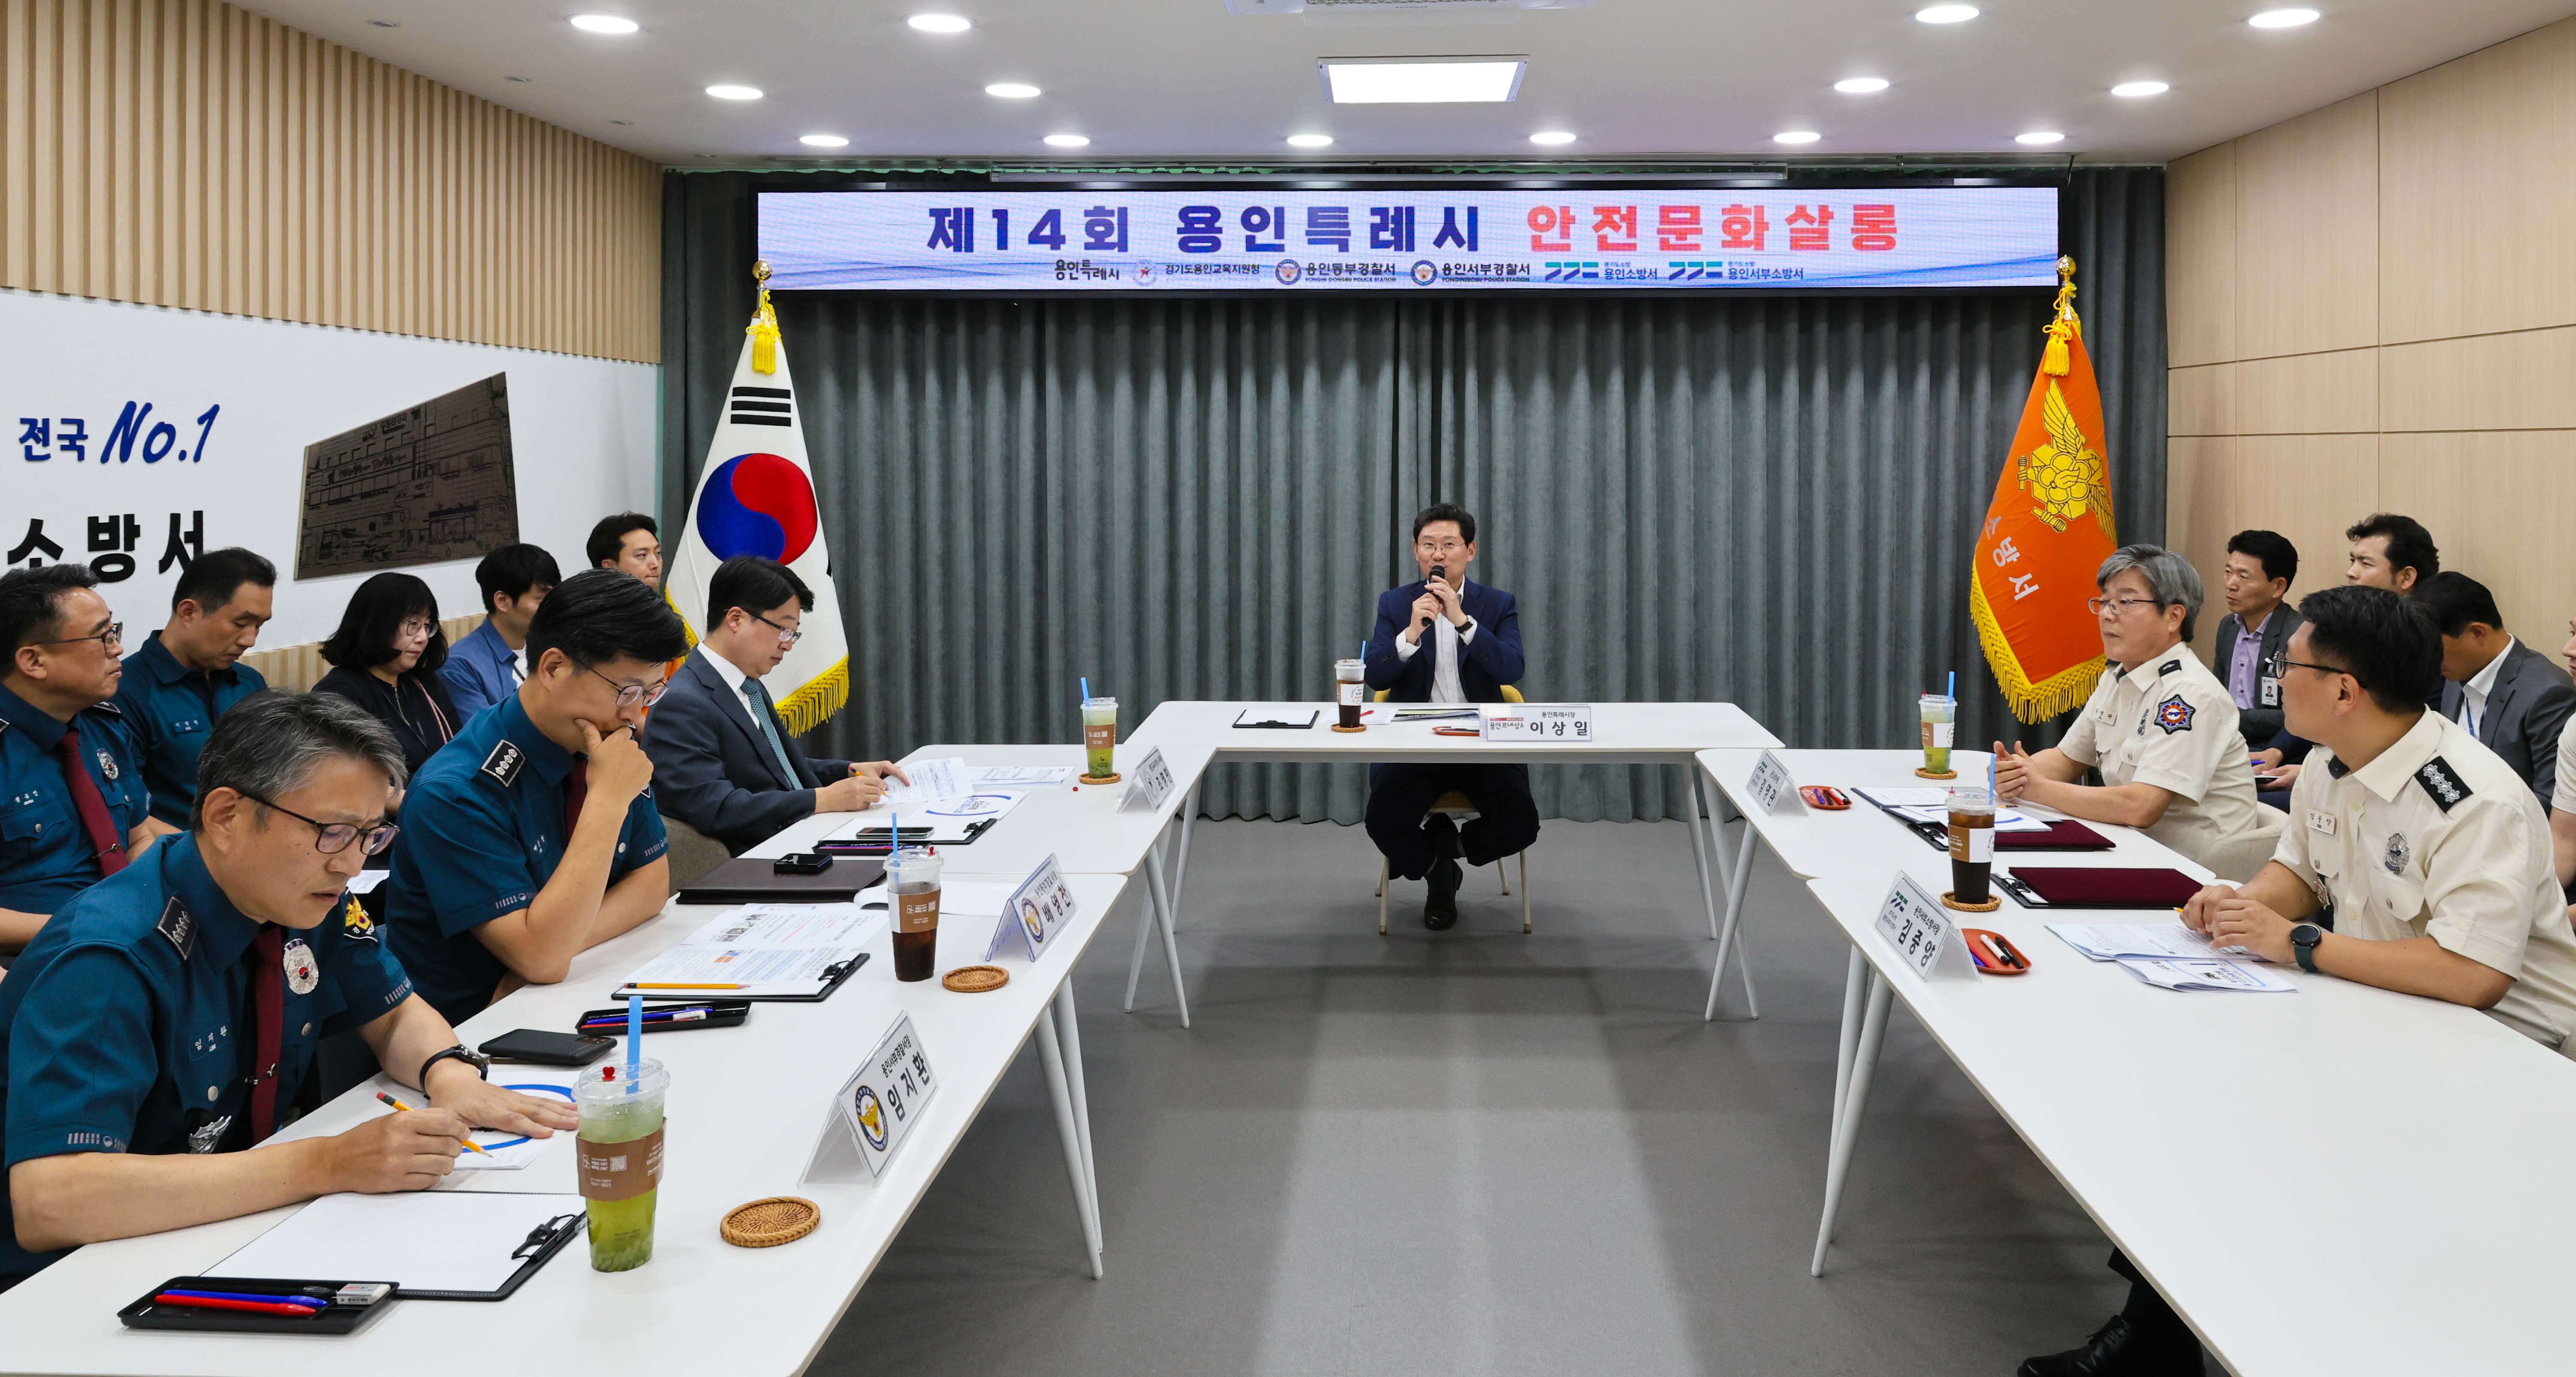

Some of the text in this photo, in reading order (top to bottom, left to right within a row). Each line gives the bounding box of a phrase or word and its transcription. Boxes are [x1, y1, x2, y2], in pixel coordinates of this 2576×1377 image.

[927, 204, 1898, 253] 제14회 용인특례시 안전문화살롱
[1054, 259, 1120, 280] 용인특례시
[1165, 264, 1260, 274] 경기도용인교육지원청
[1306, 262, 1395, 276] 용인동부경찰서
[1442, 262, 1530, 276] 용인서부경찰서
[1604, 268, 1658, 280] 용인소방서
[1728, 267, 1803, 279] 용인서부소방서
[18, 400, 220, 464] 전국 No.1
[7, 510, 204, 583] 소방서
[1530, 721, 1587, 736] 이상일
[1913, 905, 1941, 936] 용인서부소방서장
[1898, 918, 1935, 967] 김중양
[881, 1034, 912, 1078] 용인서부경찰서장
[887, 1052, 930, 1122] 임지환
